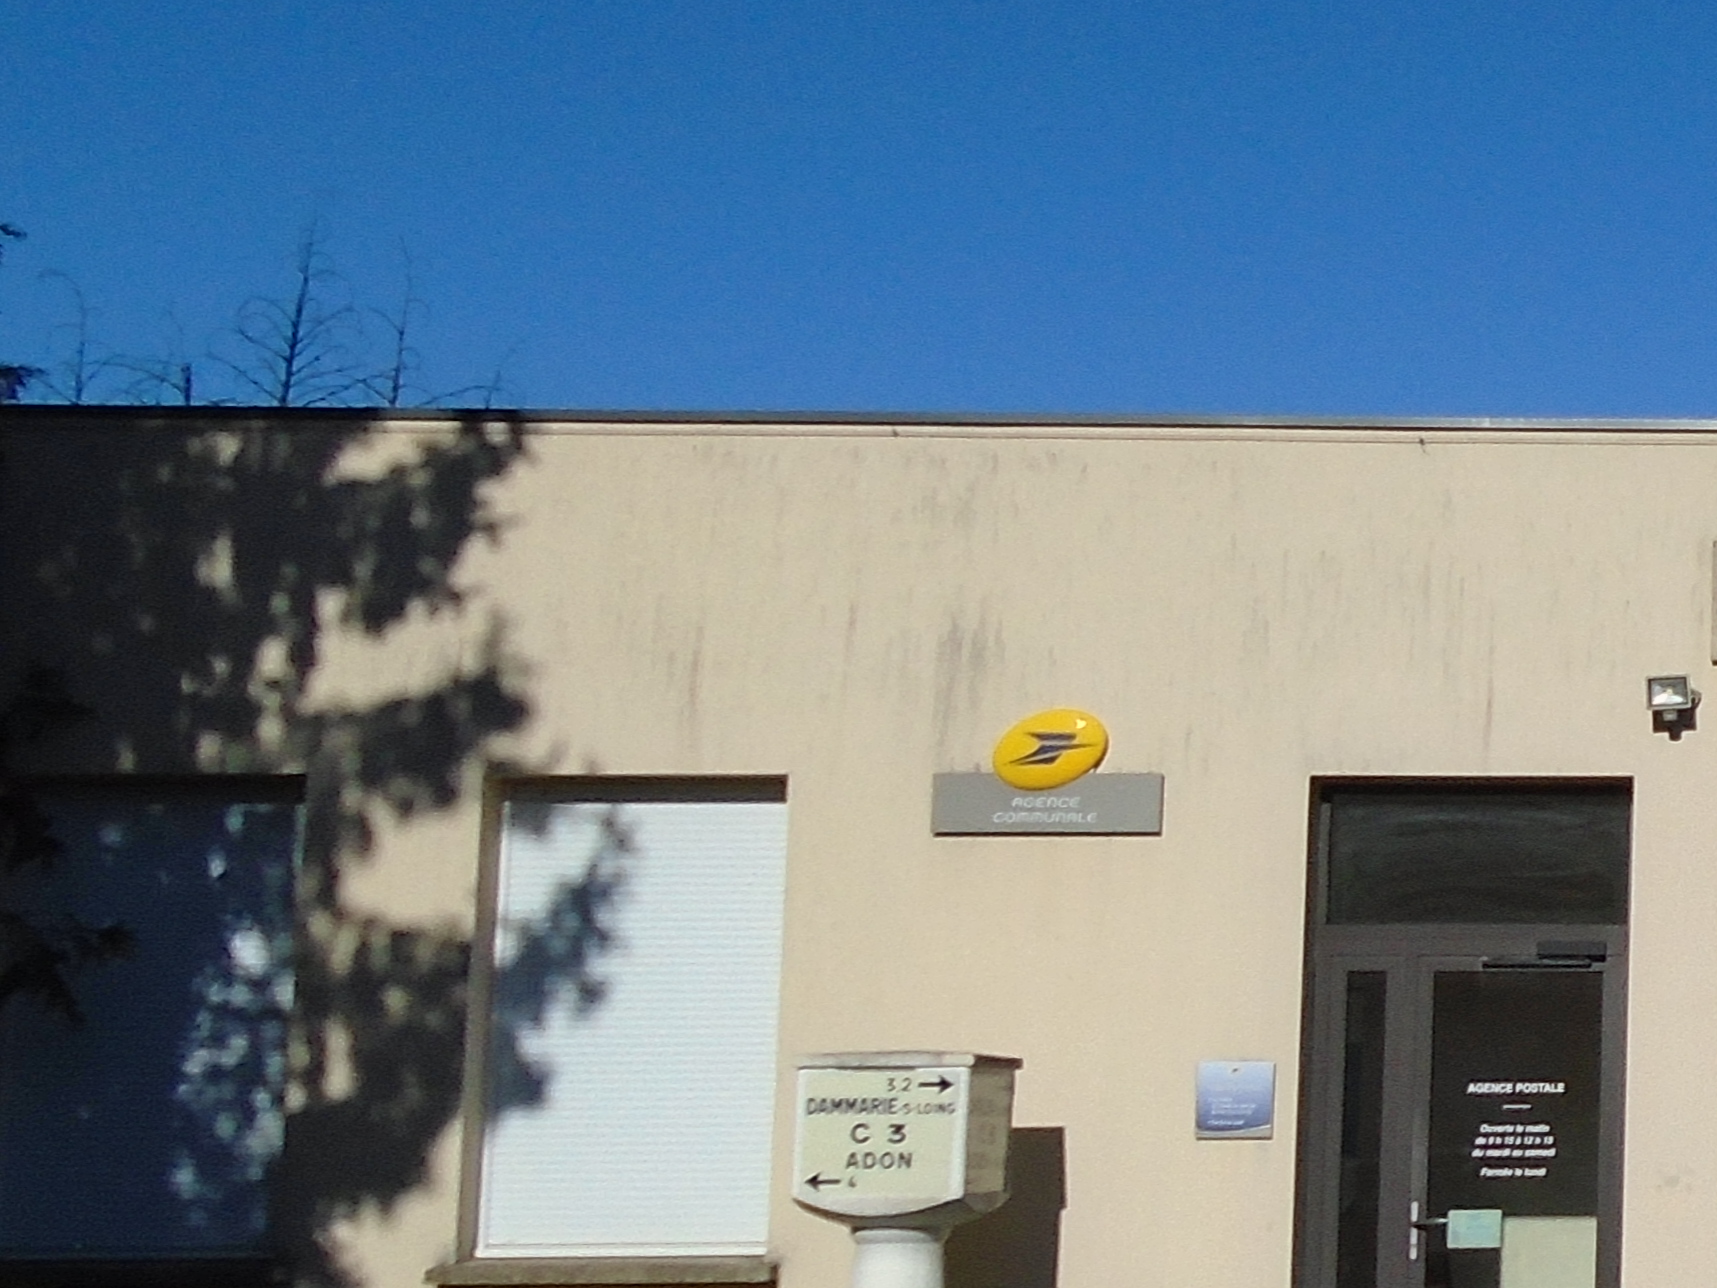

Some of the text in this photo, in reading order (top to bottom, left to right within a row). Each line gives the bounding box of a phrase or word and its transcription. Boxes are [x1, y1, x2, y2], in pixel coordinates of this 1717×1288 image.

[1011, 796, 1082, 809] AGENCE
[992, 812, 1099, 824] COMMUNALE
[1467, 1083, 1565, 1093] AGENCE POSTALE
[806, 1097, 899, 1115] DAMMARIE
[850, 1123, 907, 1144] C 3
[845, 1152, 913, 1169] ADON
